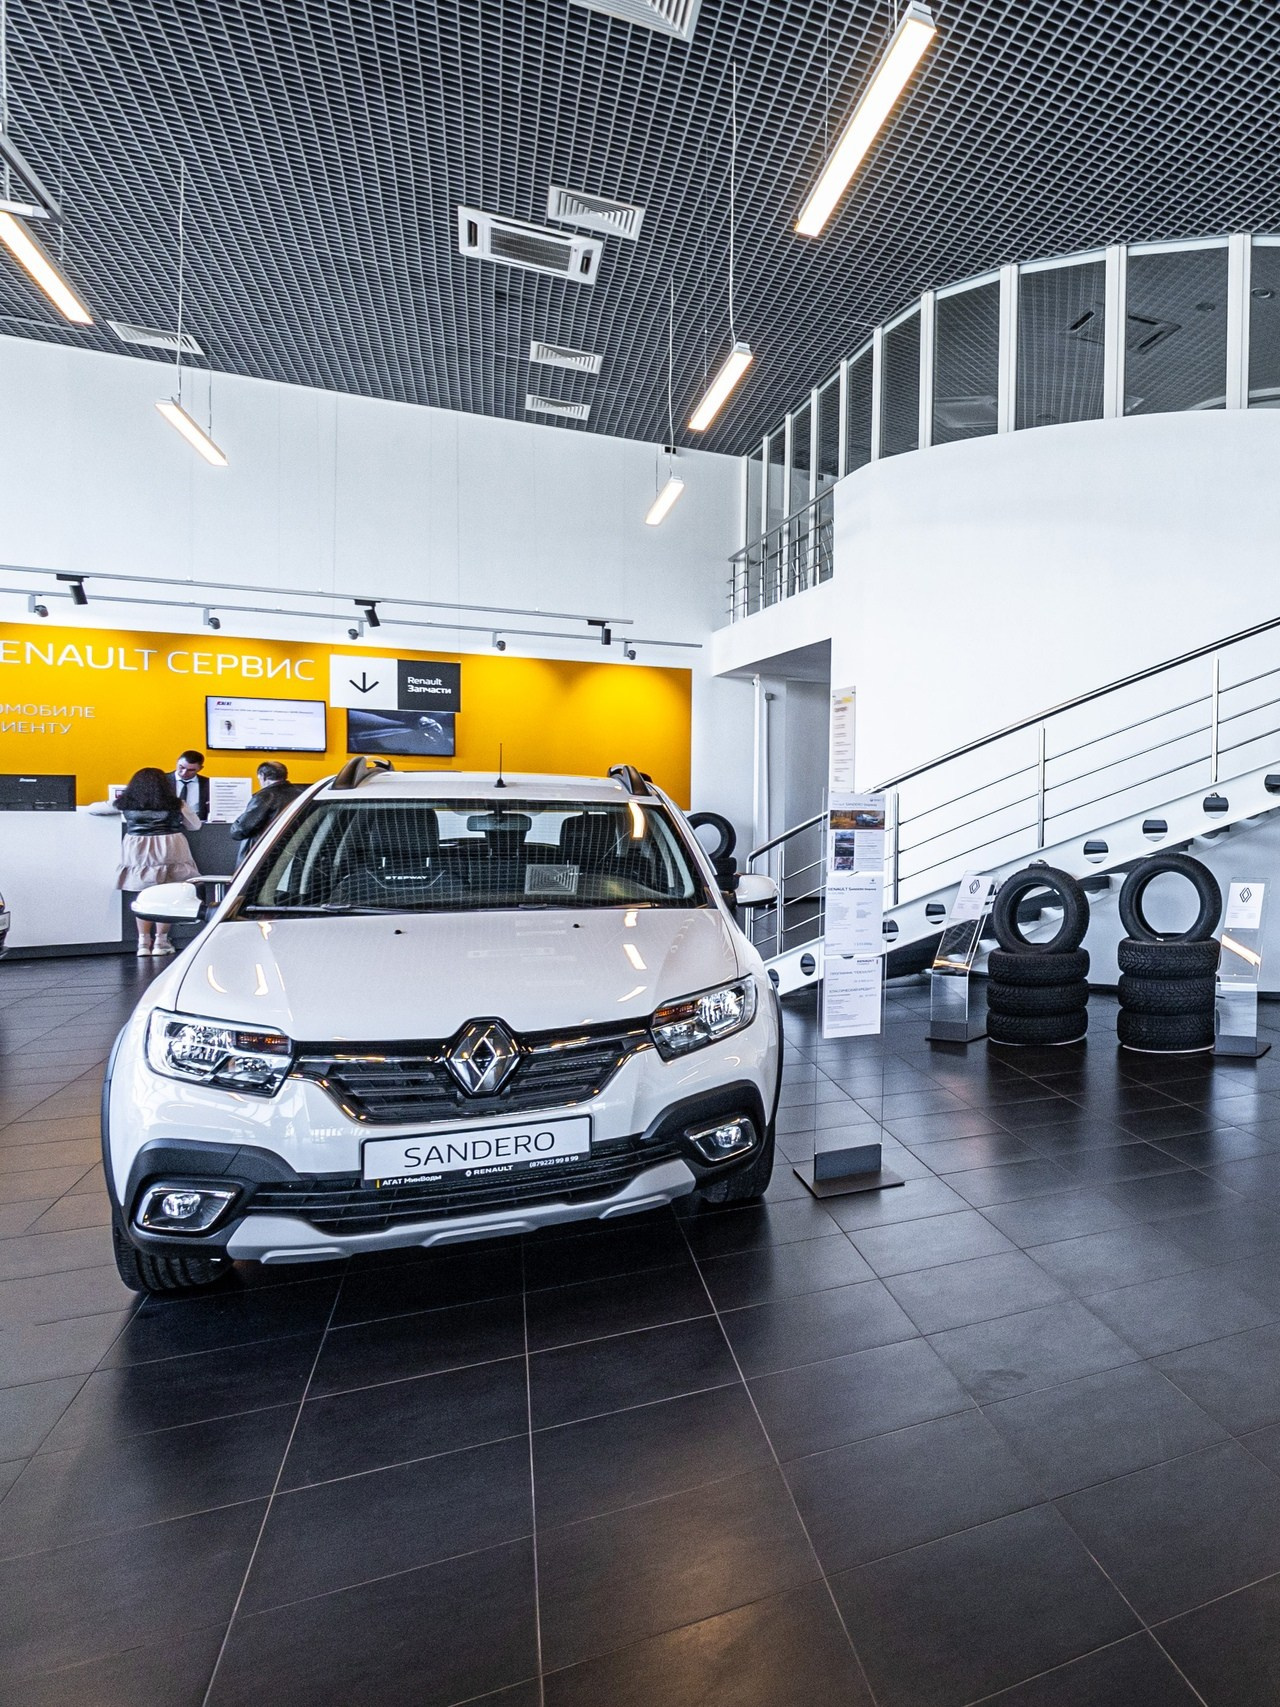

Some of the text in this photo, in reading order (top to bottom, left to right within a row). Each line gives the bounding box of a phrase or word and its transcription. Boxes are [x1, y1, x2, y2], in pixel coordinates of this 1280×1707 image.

[167, 650, 315, 682] СЕРВИС
[407, 676, 443, 686] Renault
[407, 684, 452, 694] Запчасти
[403, 1131, 555, 1168] SANDERO
[473, 1164, 514, 1175] RENAULT
[529, 1158, 555, 1168] (87922)
[382, 1178, 402, 1186] АГАТ
